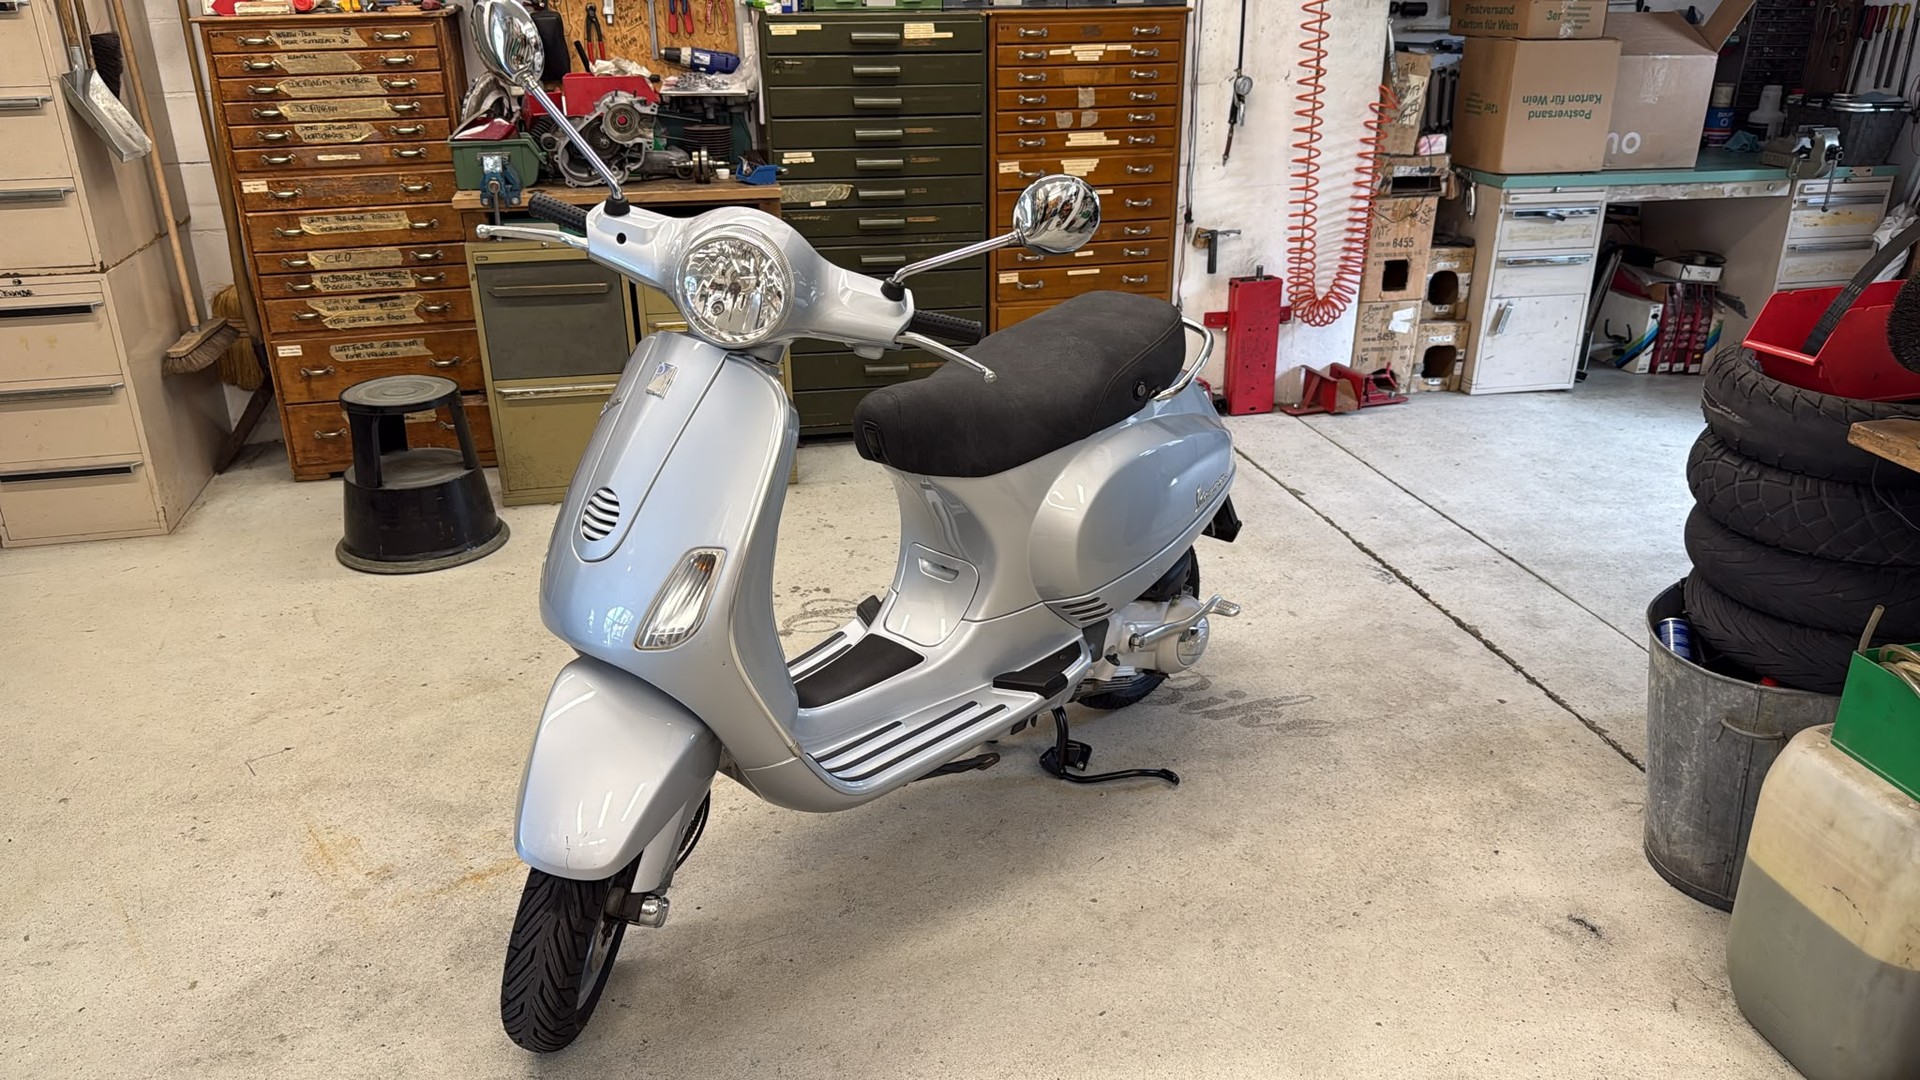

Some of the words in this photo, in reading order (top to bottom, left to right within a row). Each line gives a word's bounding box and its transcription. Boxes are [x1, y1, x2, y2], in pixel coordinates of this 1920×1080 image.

[1464, 3, 1515, 15] Postversand
[1546, 10, 1562, 20] 3er
[1457, 18, 1482, 29] Karton
[1498, 19, 1519, 30] Wein
[1522, 95, 1548, 106] Wein
[1550, 94, 1565, 105] für
[1568, 94, 1602, 105] Karton
[1528, 109, 1592, 120] Postversand
[1392, 237, 1414, 248] 6455
